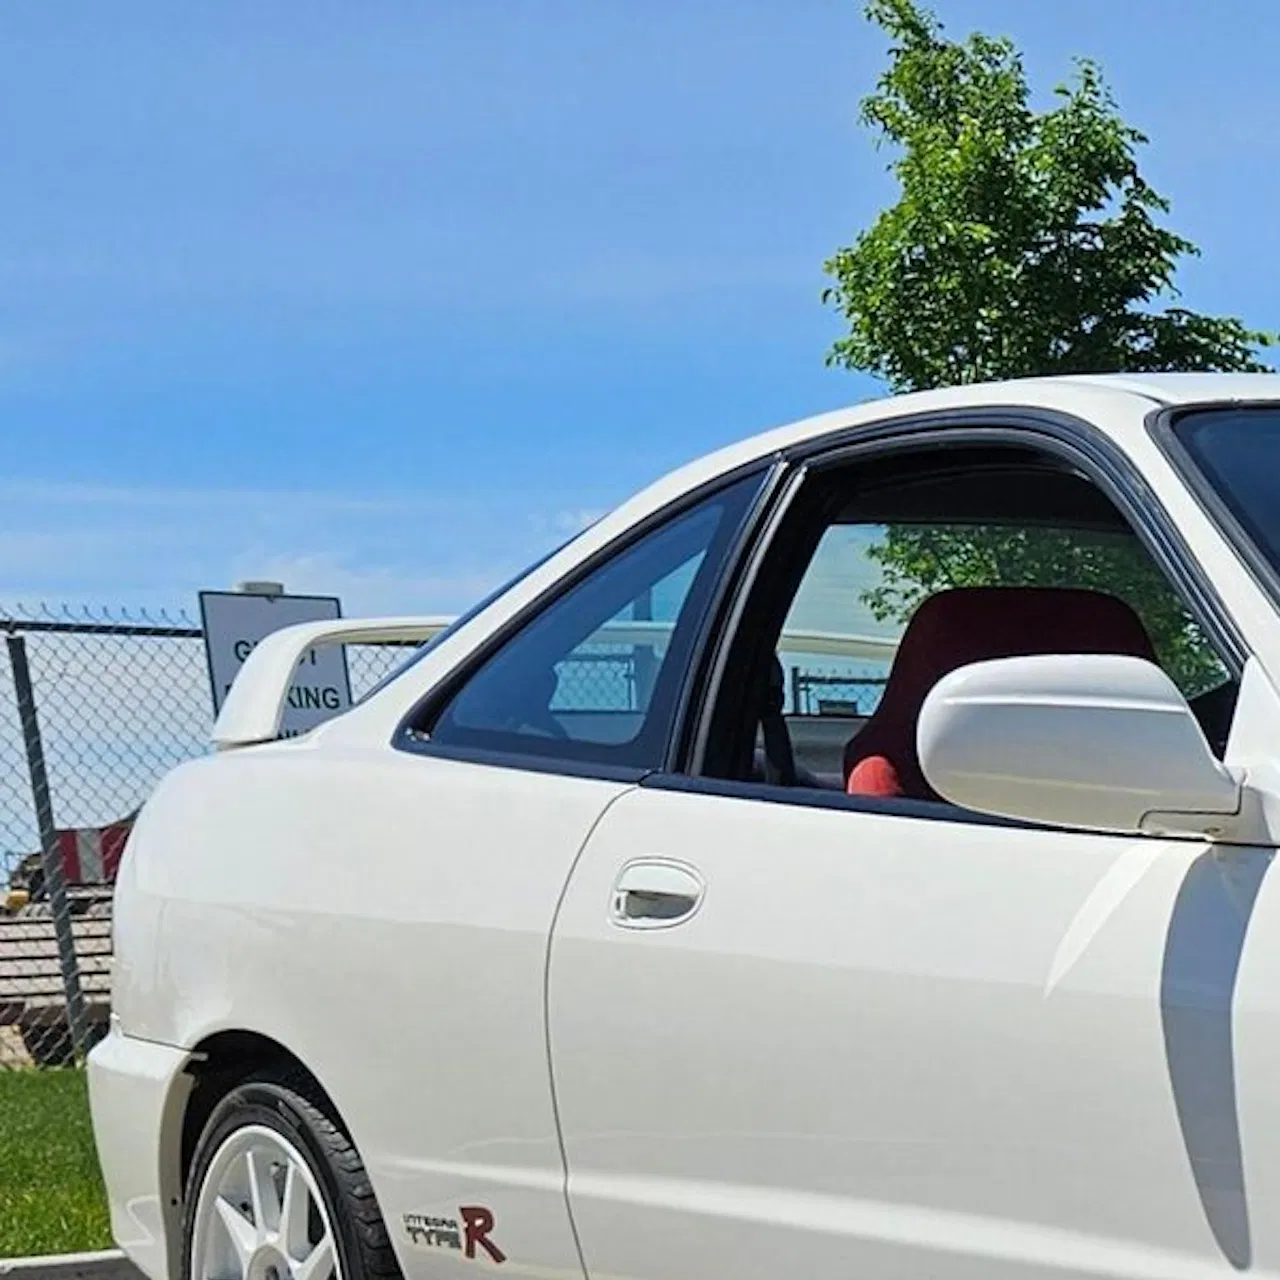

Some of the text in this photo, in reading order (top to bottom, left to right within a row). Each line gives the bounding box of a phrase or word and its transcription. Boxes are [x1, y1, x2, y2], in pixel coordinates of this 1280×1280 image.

[225, 684, 340, 709] KING
[406, 1206, 507, 1263] TYPE R
